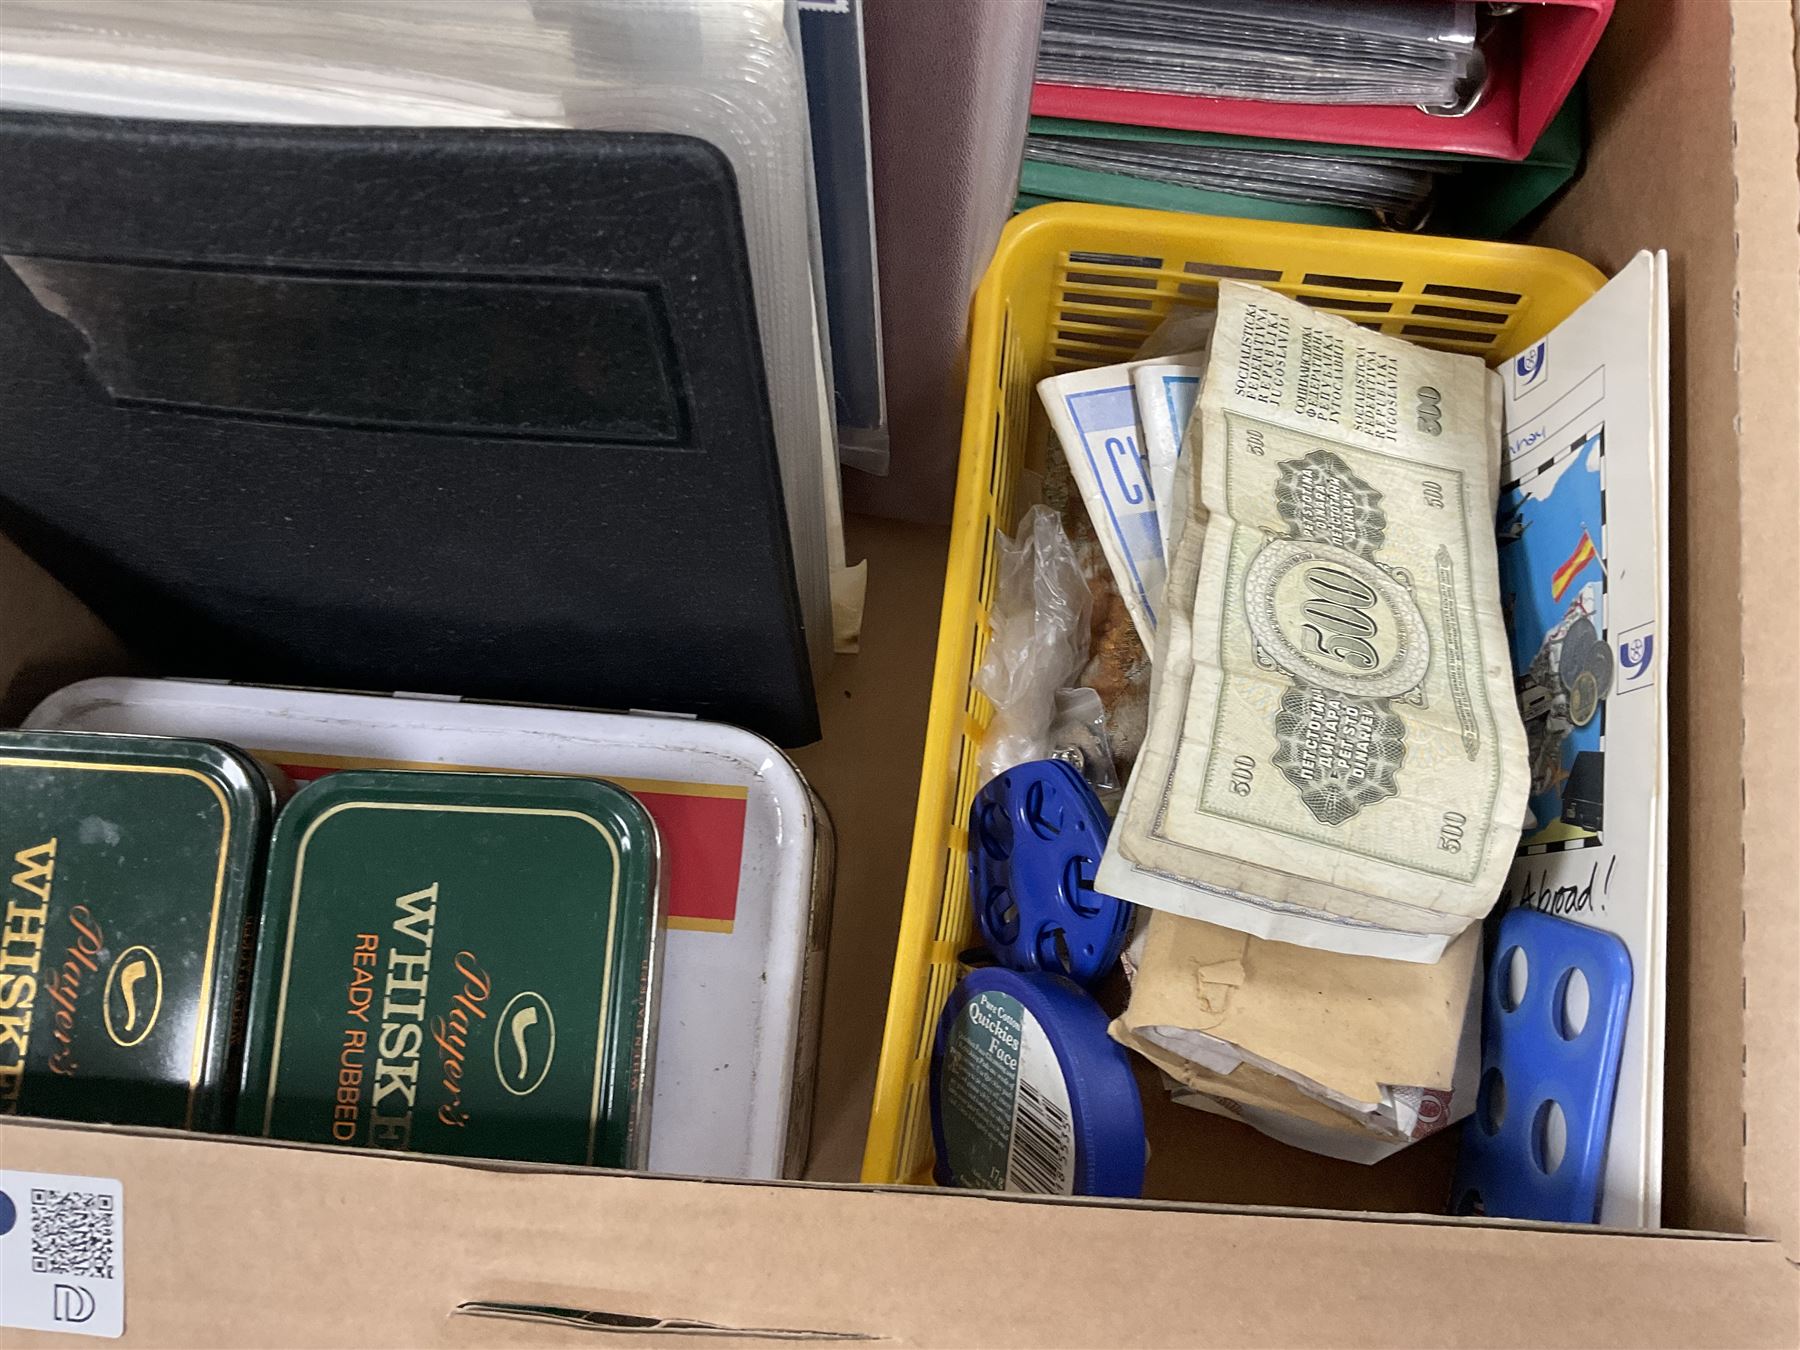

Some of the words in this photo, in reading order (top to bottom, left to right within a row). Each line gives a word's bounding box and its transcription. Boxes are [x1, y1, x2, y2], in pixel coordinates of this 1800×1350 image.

[1246, 308, 1268, 401] FEDERATIVNA
[1257, 312, 1279, 404] REPUBLIKA
[1269, 317, 1290, 407] JUGOSLAVIJA
[1363, 351, 1377, 436] FEDERATIVNA
[1373, 354, 1388, 439] REPUBLIKA
[1386, 358, 1398, 442] JUGOSLAVIJA
[1416, 386, 1443, 437] 500
[1246, 429, 1265, 456] 500
[1422, 480, 1445, 509] 500
[1301, 567, 1379, 670] 500
[1319, 700, 1341, 769] ДИНАРА
[1337, 740, 1355, 769] PET
[1343, 705, 1360, 736] STO
[1352, 704, 1375, 779] DINARJEV
[1230, 755, 1256, 797] 500
[1437, 811, 1467, 854] 500
[1520, 854, 1616, 916] Abroad!
[346, 933, 380, 1023] READY
[430, 950, 492, 1128] Player's
[969, 1002, 1020, 1051] Quickies
[980, 994, 998, 1014] Pure
[997, 1006, 1022, 1032] Cotton
[332, 1029, 368, 1142] RUBBED
[988, 1037, 1018, 1071] Face
